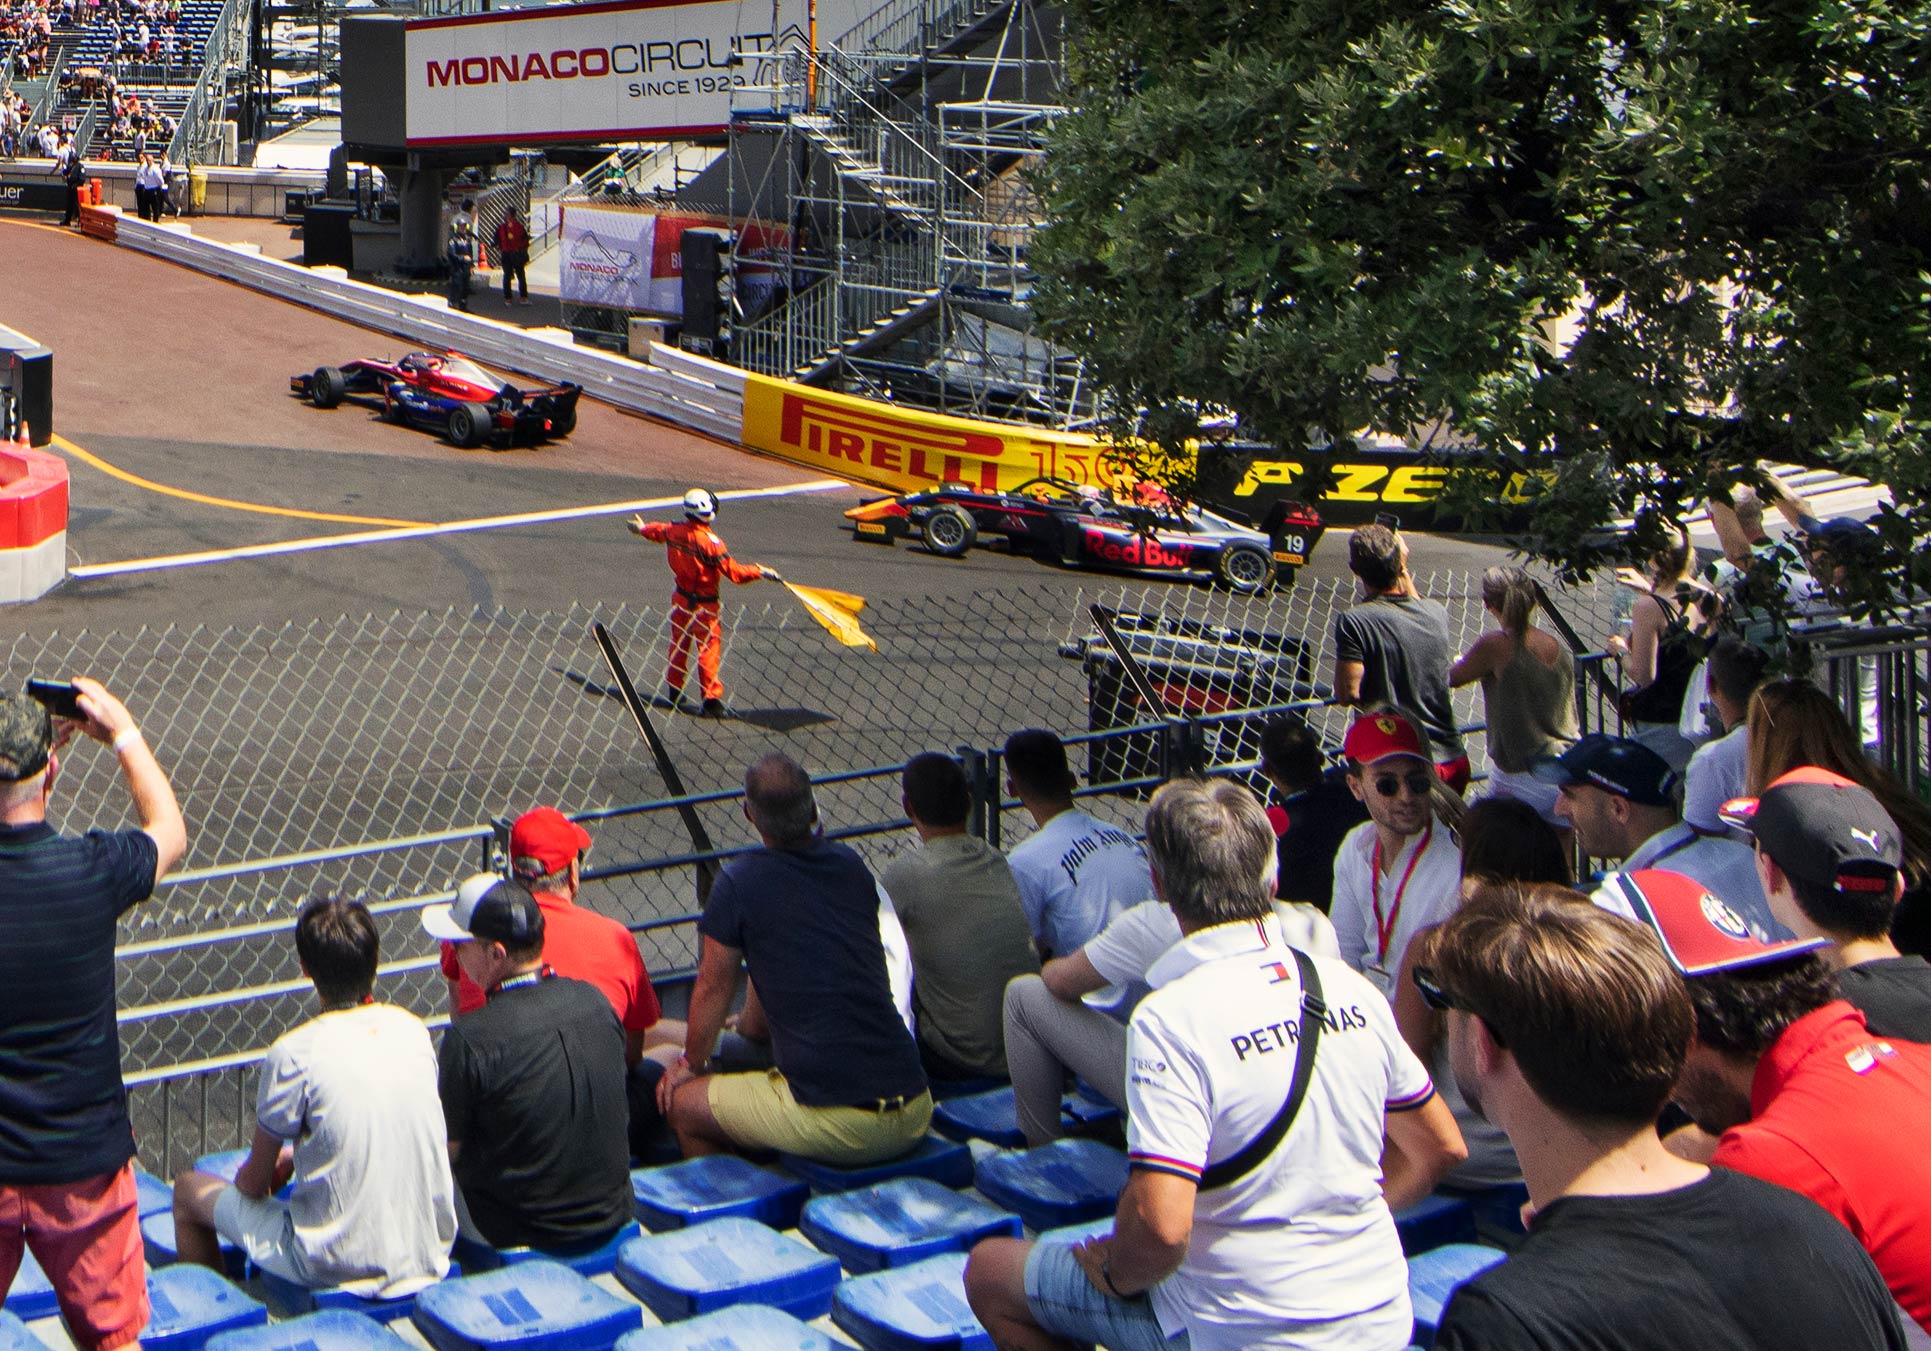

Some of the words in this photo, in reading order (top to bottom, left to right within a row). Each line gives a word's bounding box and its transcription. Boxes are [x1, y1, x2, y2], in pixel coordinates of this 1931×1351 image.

[629, 80, 690, 97] SINCE
[570, 262, 619, 275] MONACO
[780, 393, 1004, 490] PIRELLI
[1086, 529, 1140, 565] Red
[1284, 534, 1304, 553] 19
[1230, 1005, 1367, 1061] PETRNAS
